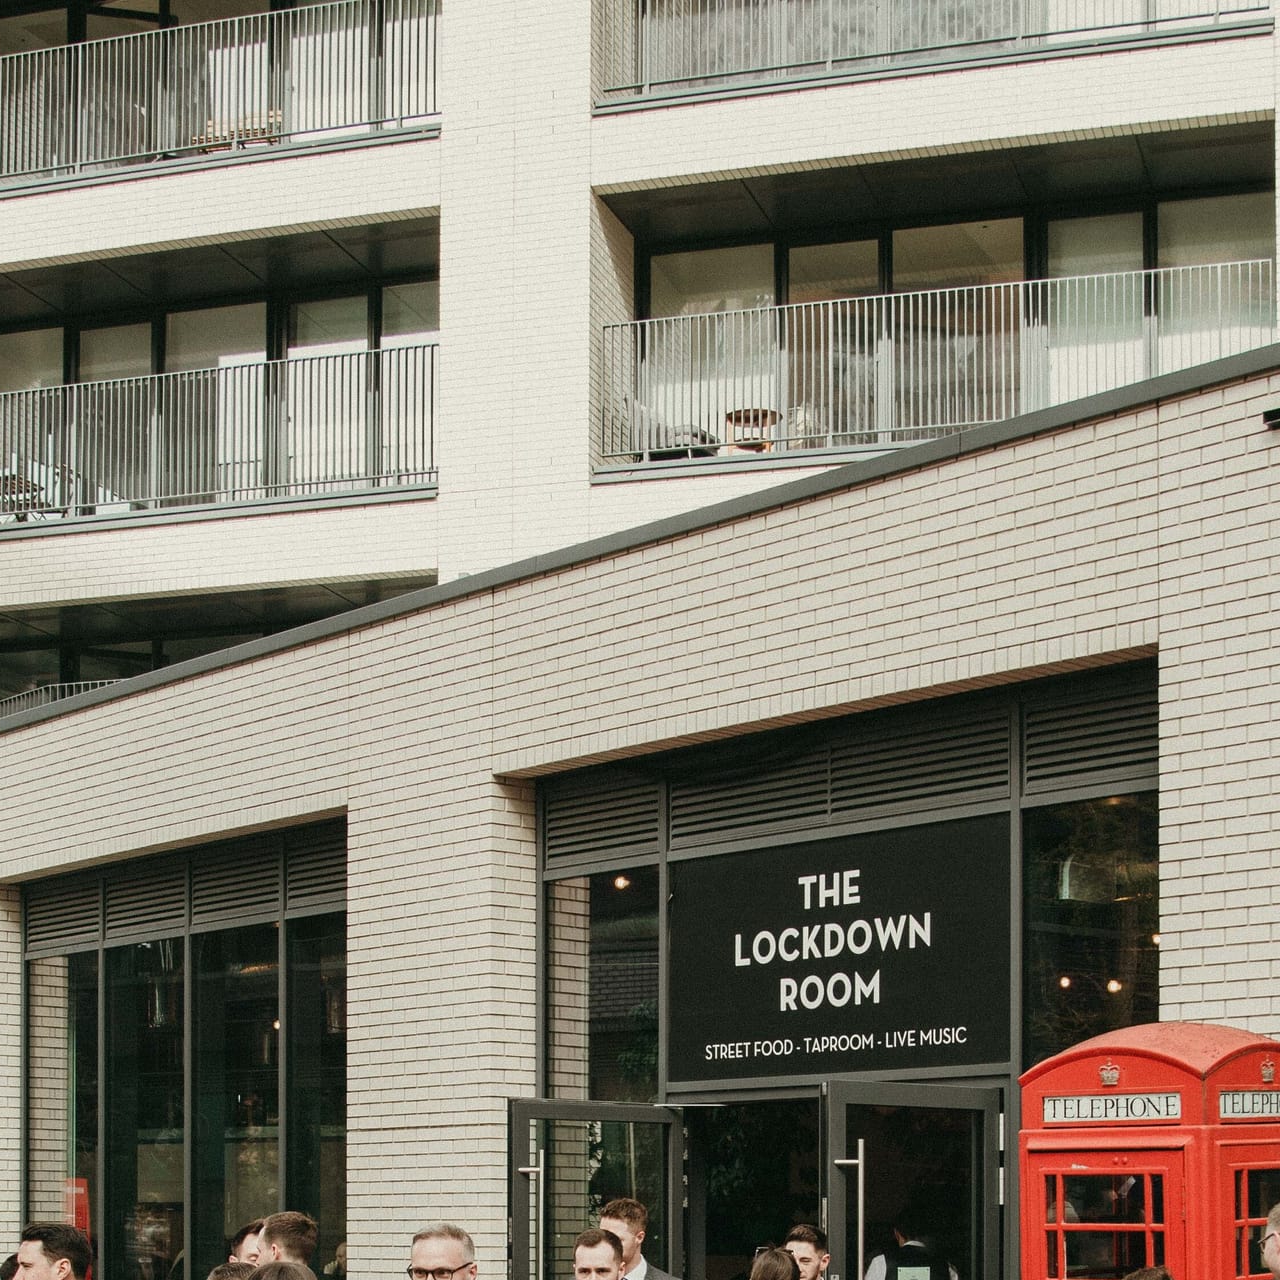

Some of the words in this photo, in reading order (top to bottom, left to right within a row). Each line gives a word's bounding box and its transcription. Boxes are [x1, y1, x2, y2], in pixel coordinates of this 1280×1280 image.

[798, 869, 861, 910] THE
[734, 912, 932, 967] LOCKDOWN
[779, 969, 881, 1012] ROOM
[705, 1042, 751, 1060] STREET
[754, 1039, 794, 1057] FOOD
[803, 1033, 874, 1054] TAPROOM
[885, 1030, 916, 1049] LIVE
[920, 1026, 968, 1047] MUSIC
[1046, 1095, 1178, 1120] TELEPHONE
